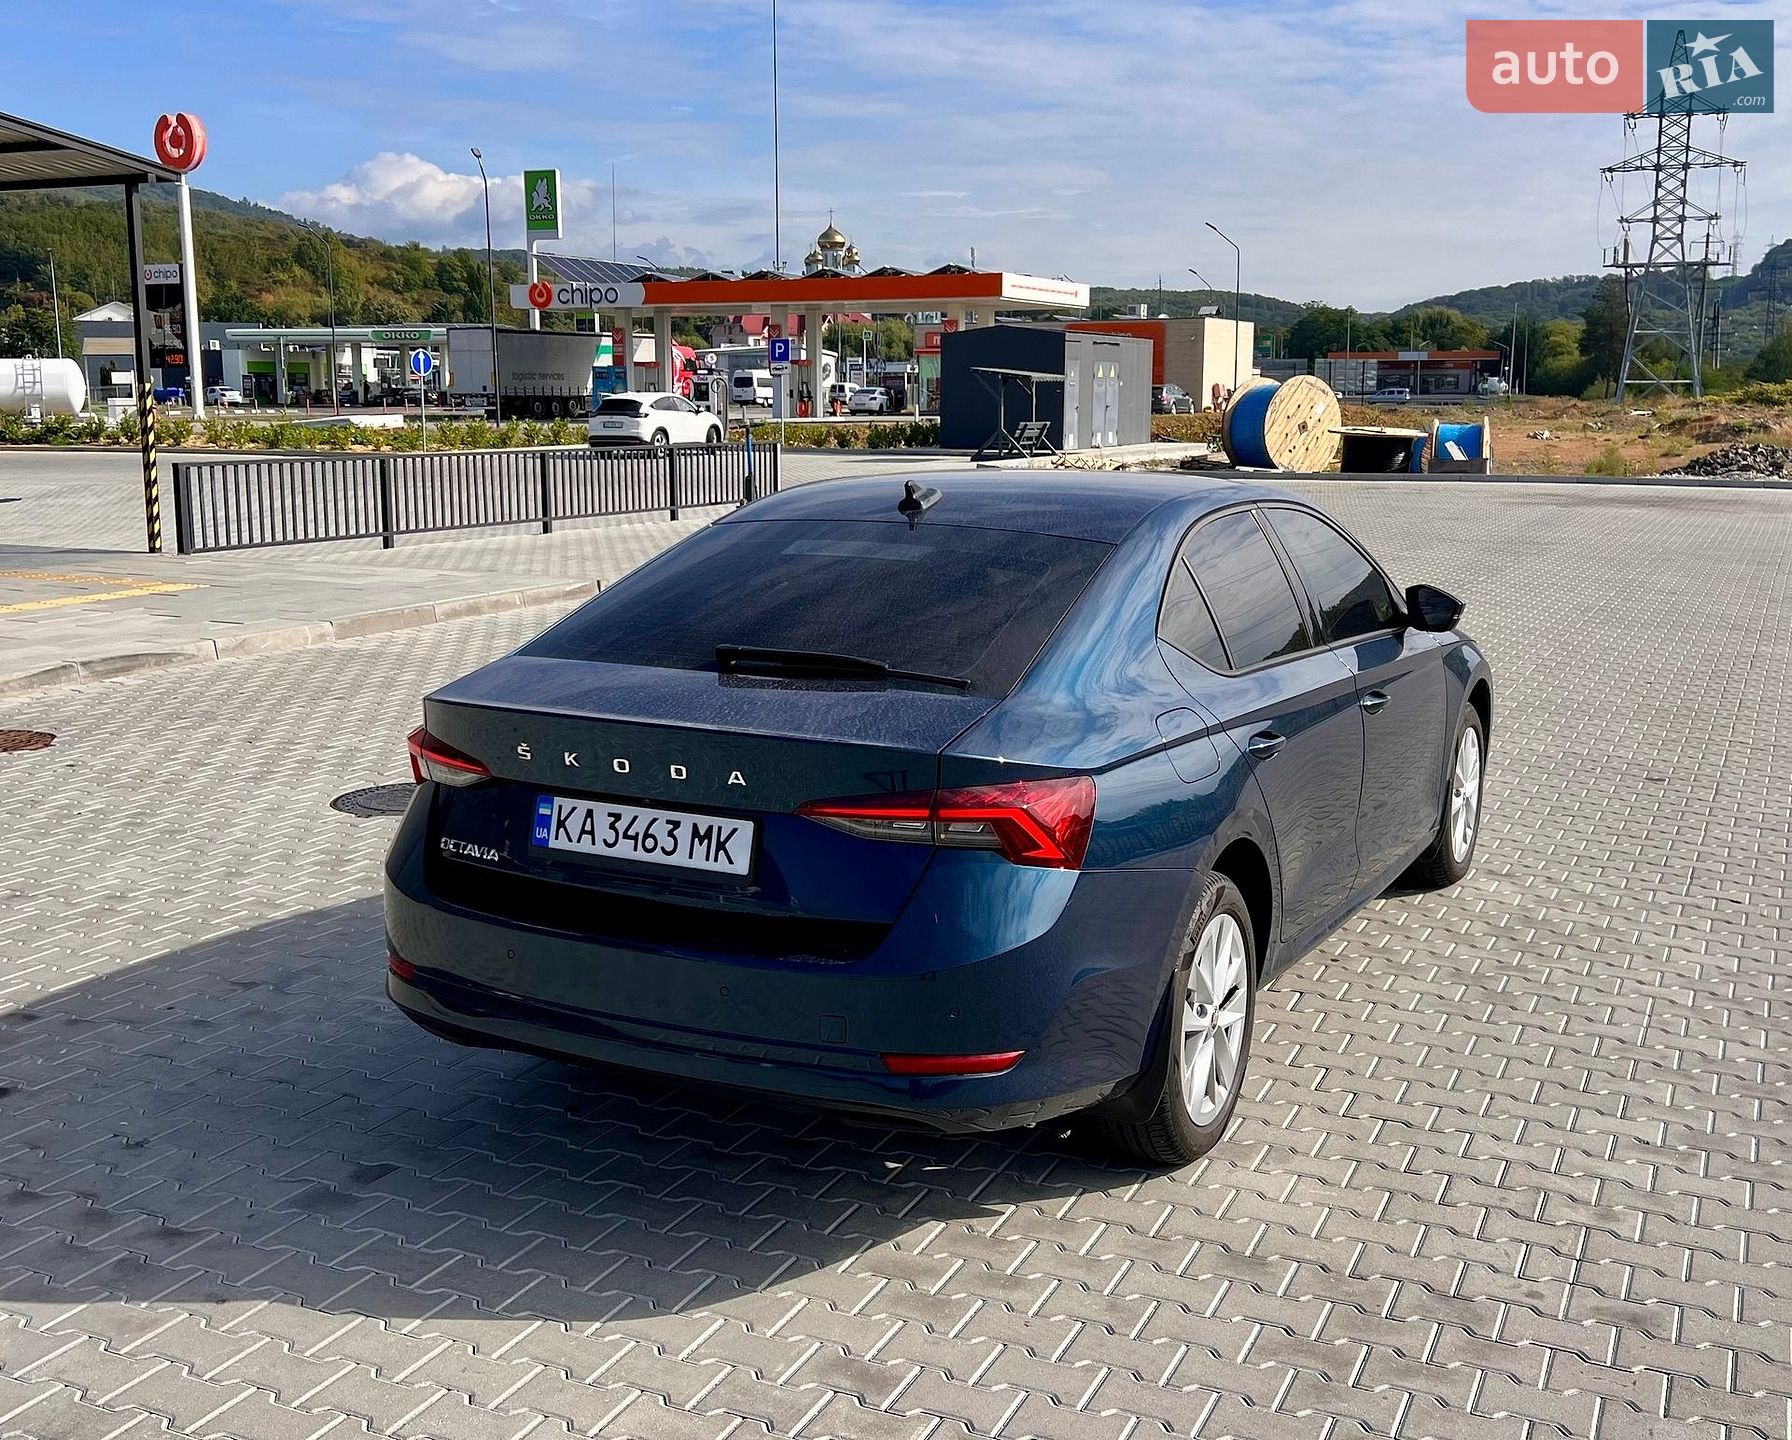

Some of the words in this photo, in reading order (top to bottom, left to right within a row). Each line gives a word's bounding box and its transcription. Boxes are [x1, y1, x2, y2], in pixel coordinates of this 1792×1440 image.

[153, 268, 178, 280] chipo
[557, 282, 619, 309] chipo
[382, 331, 420, 339] OKKO
[775, 343, 785, 358] P
[517, 742, 747, 786] ŠKODA
[535, 827, 549, 839] UA
[440, 837, 499, 861] OCTAVIA
